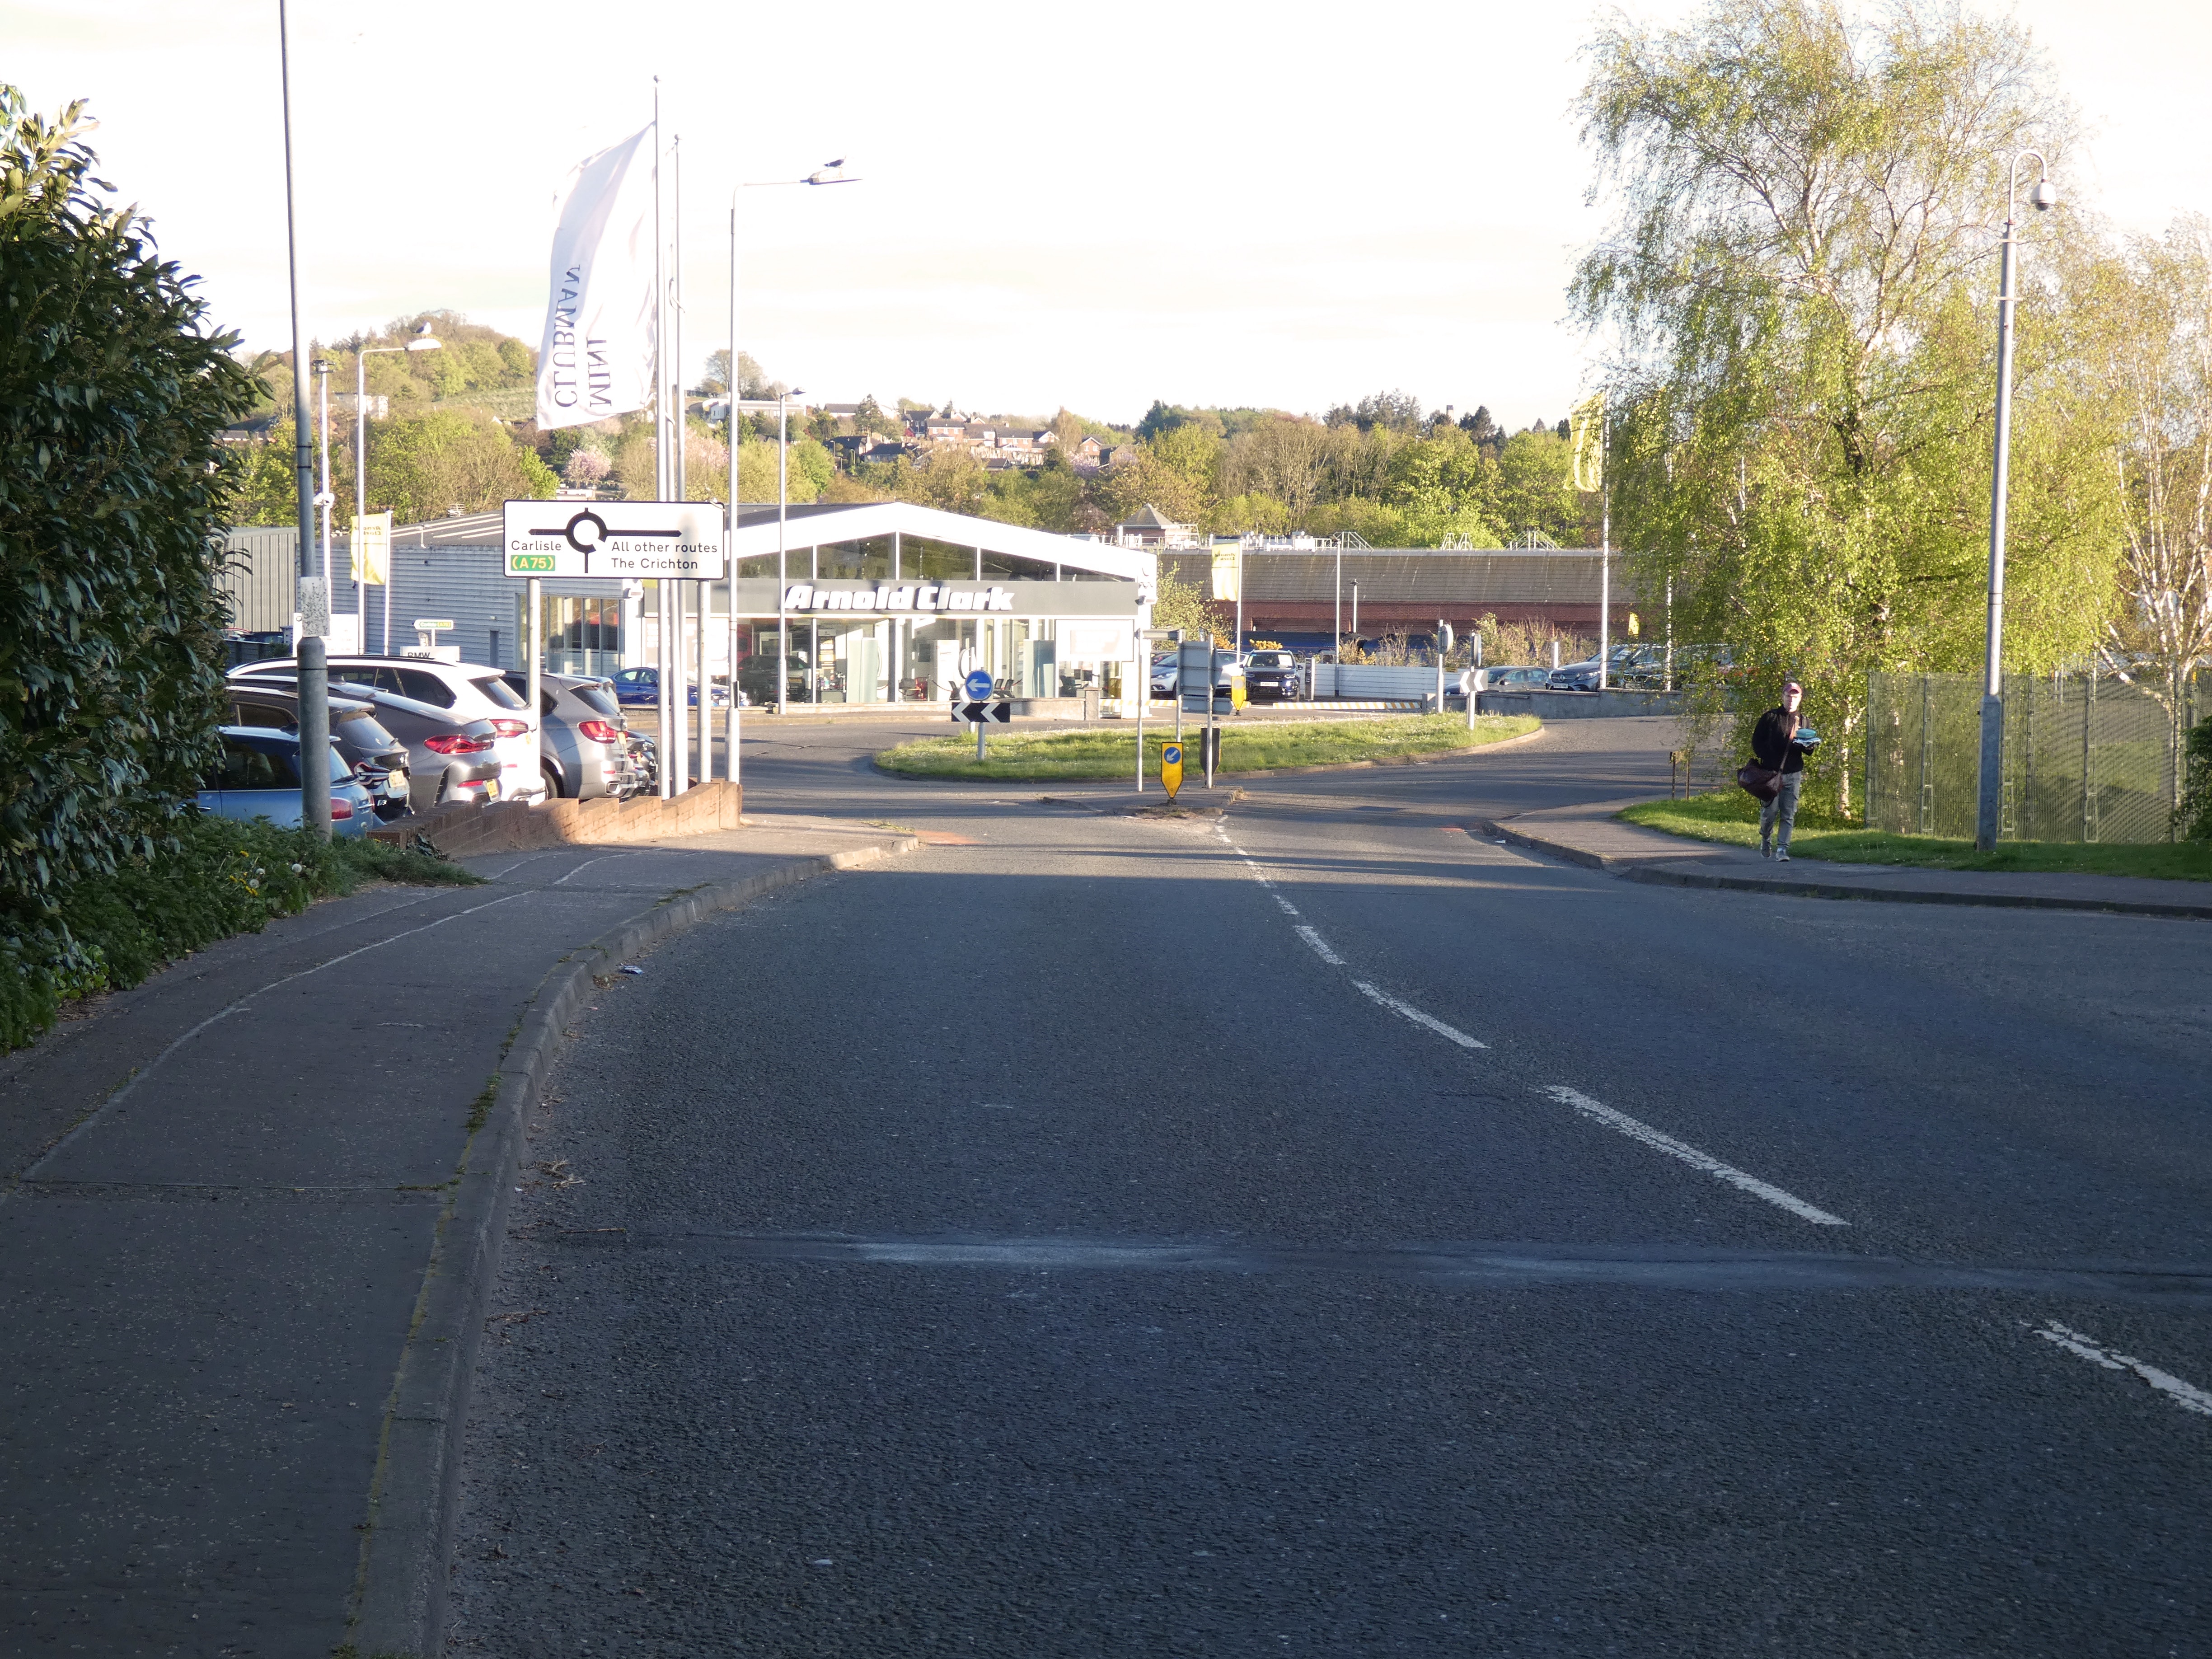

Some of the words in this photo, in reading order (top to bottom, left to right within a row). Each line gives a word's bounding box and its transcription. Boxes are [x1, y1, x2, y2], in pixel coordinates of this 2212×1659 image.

[511, 540, 562, 551] Carlisle
[611, 542, 629, 552] All
[634, 542, 670, 552] other
[675, 544, 717, 553] routes
[511, 557, 554, 570] (A75)
[611, 558, 635, 568] The
[640, 558, 698, 569] Crichton
[784, 586, 914, 610] Arnold
[914, 586, 1015, 611] Clark
